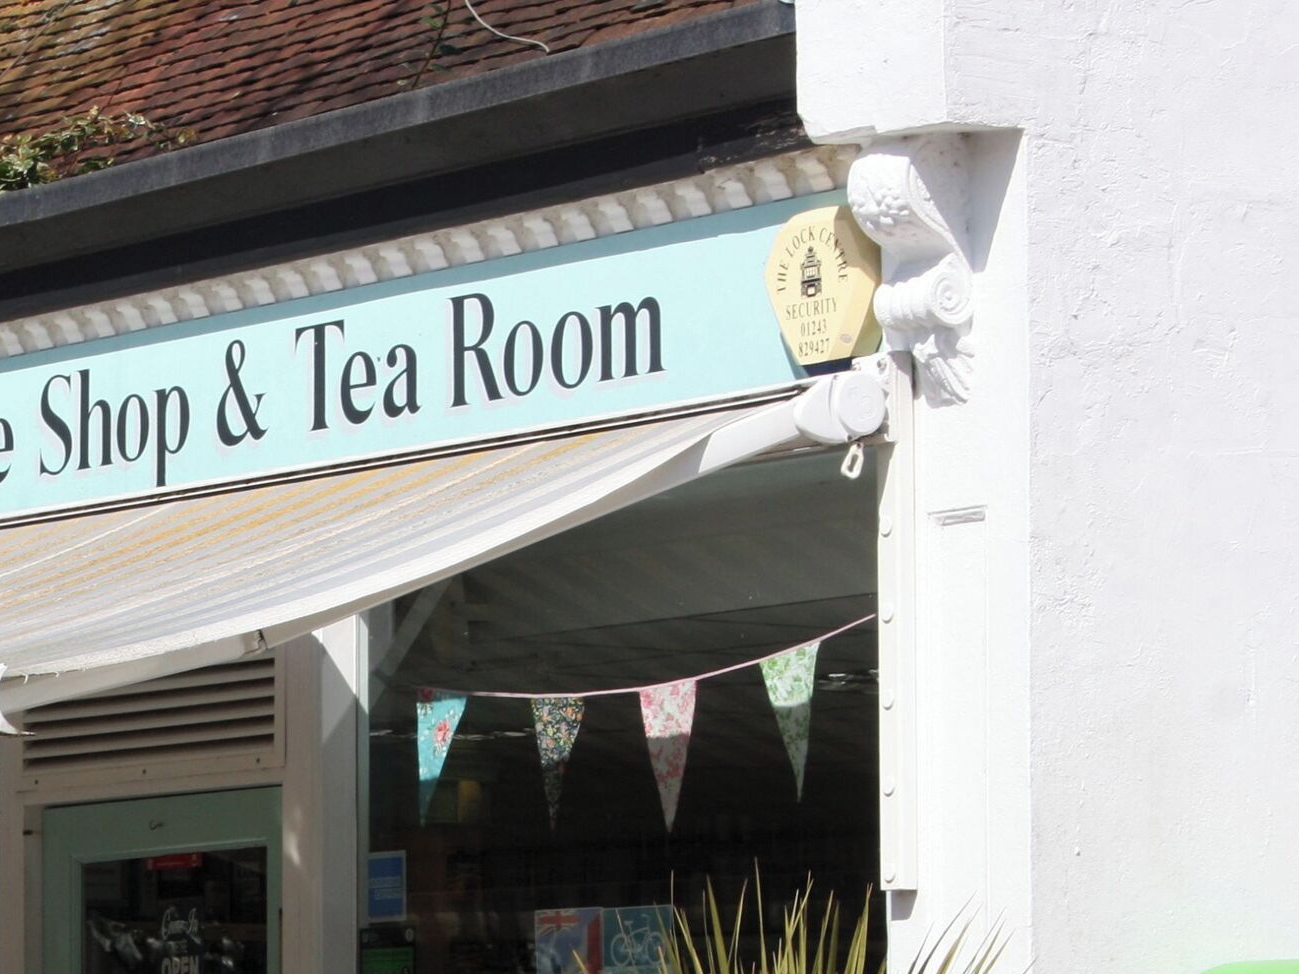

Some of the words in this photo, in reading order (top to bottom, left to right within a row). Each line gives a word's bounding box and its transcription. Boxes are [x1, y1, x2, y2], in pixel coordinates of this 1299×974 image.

[777, 259, 790, 293] THE
[785, 226, 815, 258] LOCK
[819, 226, 849, 283] CENTRE
[785, 297, 838, 321] SECURITY
[800, 319, 828, 336] 01243
[39, 369, 190, 487] Shop
[216, 339, 268, 446] &
[294, 319, 421, 432] Tea
[449, 292, 665, 409] Room
